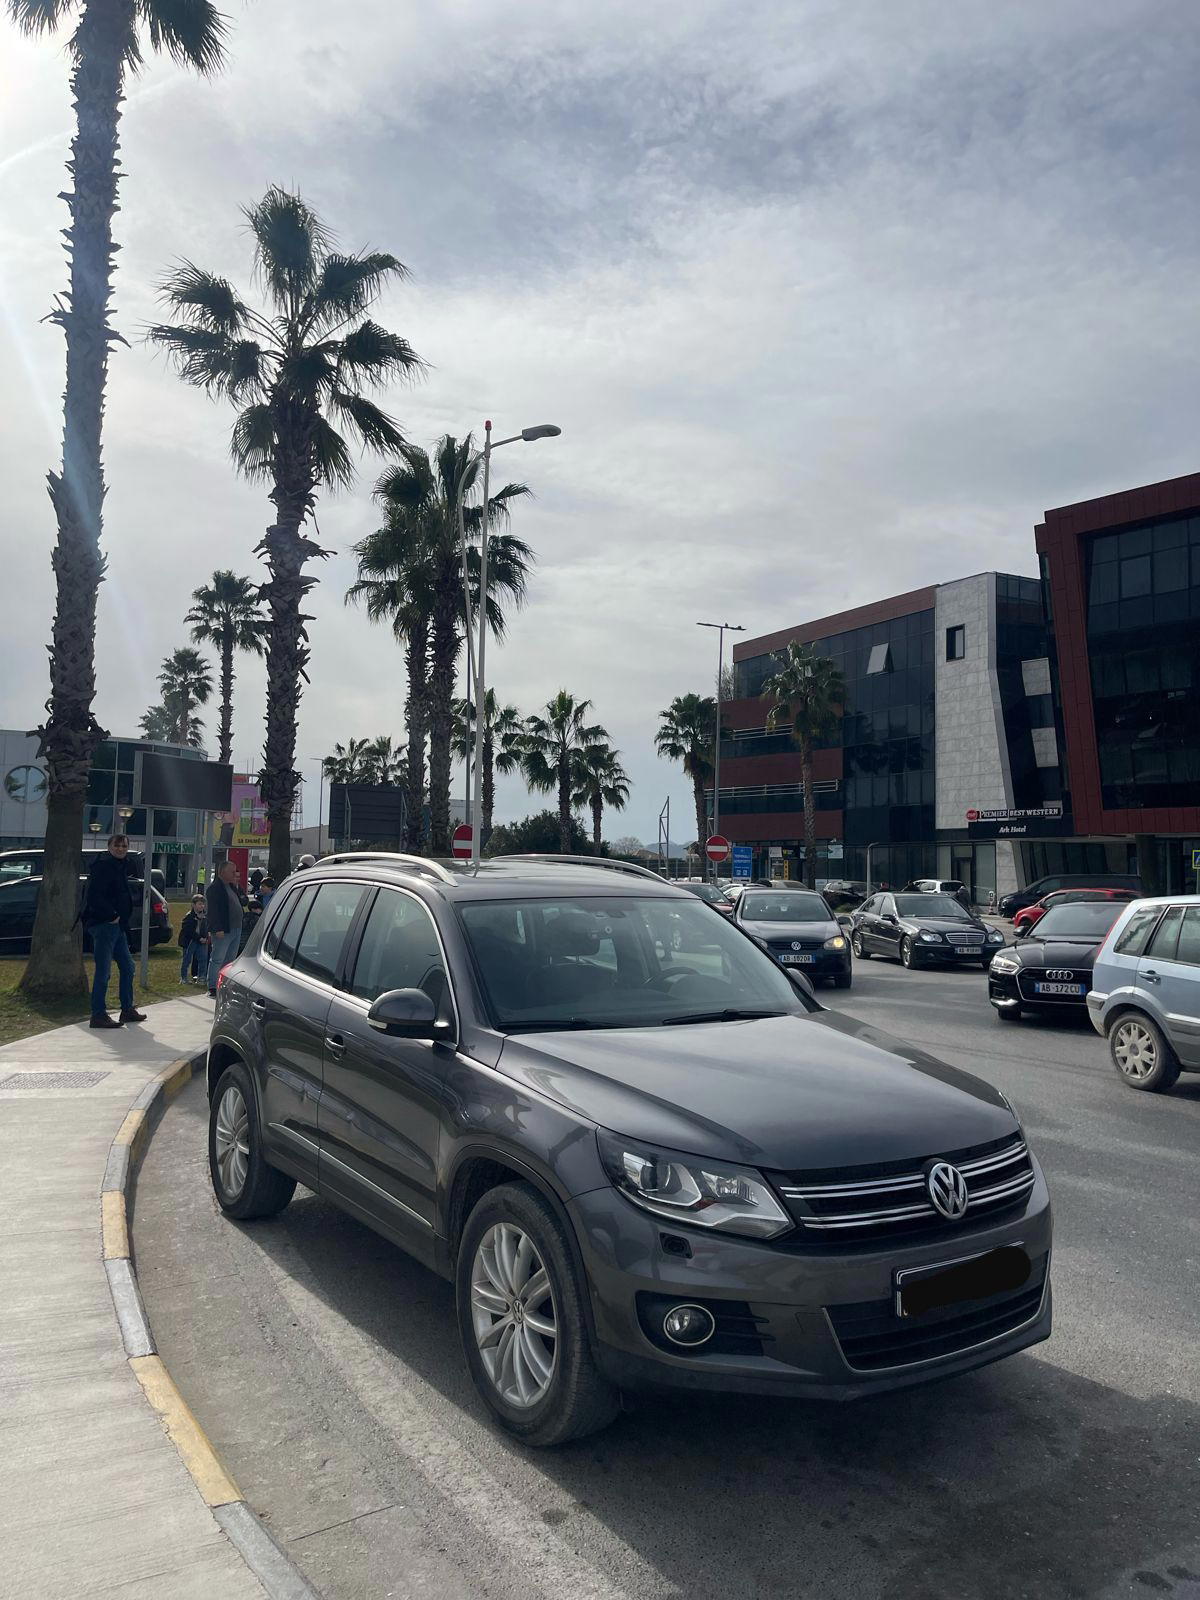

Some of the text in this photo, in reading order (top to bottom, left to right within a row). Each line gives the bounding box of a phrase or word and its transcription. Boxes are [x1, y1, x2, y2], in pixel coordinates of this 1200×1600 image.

[980, 808, 1058, 818] PREMIER BEST WESTERN
[1010, 825, 1026, 833] Hotel
[1041, 983, 1051, 992] AB
